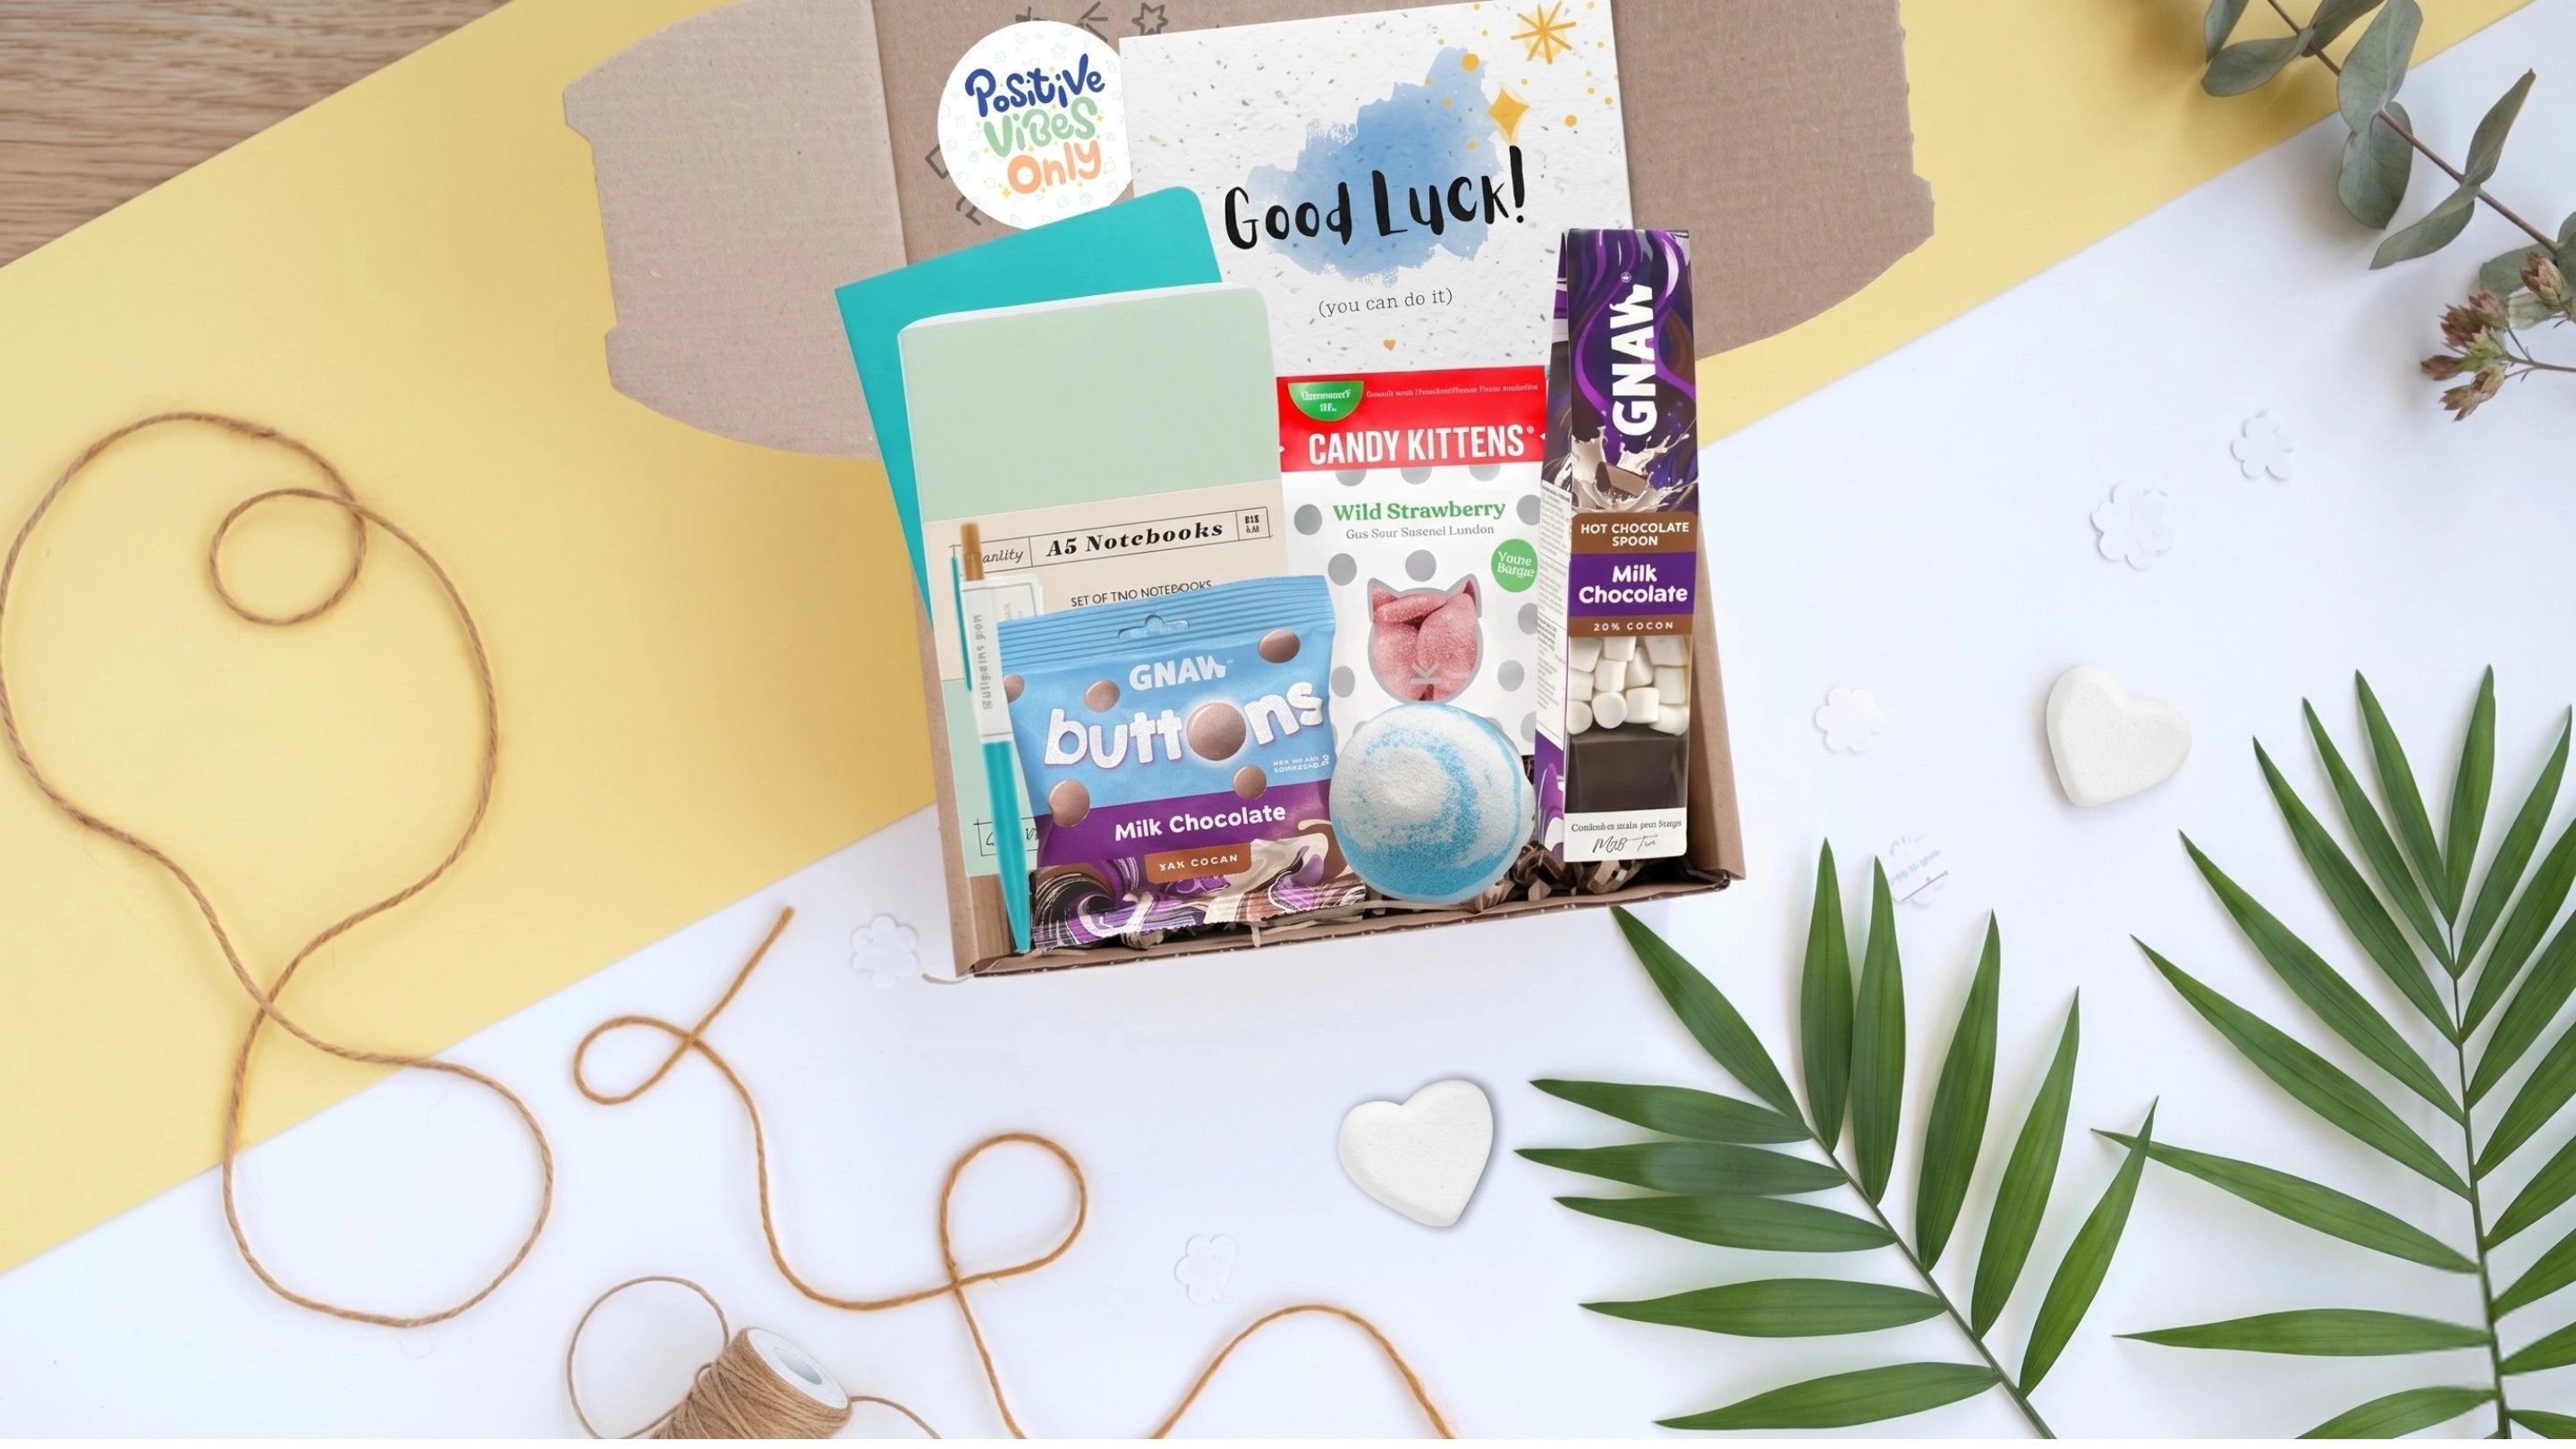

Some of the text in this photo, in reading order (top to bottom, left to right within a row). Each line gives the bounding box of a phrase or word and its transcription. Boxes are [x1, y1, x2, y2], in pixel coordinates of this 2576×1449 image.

[1007, 140, 1101, 194] Only
[1224, 182, 1352, 250] Good
[1318, 287, 1453, 318] (you can do it)
[1609, 284, 1657, 436] GNAW
[1309, 424, 1525, 466] CANDY KITTENS
[1333, 500, 1506, 521] Wild Strawberry
[1046, 538, 1078, 557] A5
[1085, 522, 1224, 553] Notebooks
[1580, 521, 1690, 535] HOT CHOCOLATE
[1612, 536, 1658, 547] SPOON
[1612, 564, 1657, 583] Milk
[1071, 595, 1089, 607] SET
[1092, 593, 1109, 605] OF
[1578, 585, 1688, 604] Chocolate
[1593, 623, 1620, 631] 20%
[1129, 655, 1227, 691] GNAW
[1114, 805, 1286, 841] Milk Chocolate
[1191, 854, 1238, 868] COCAN
